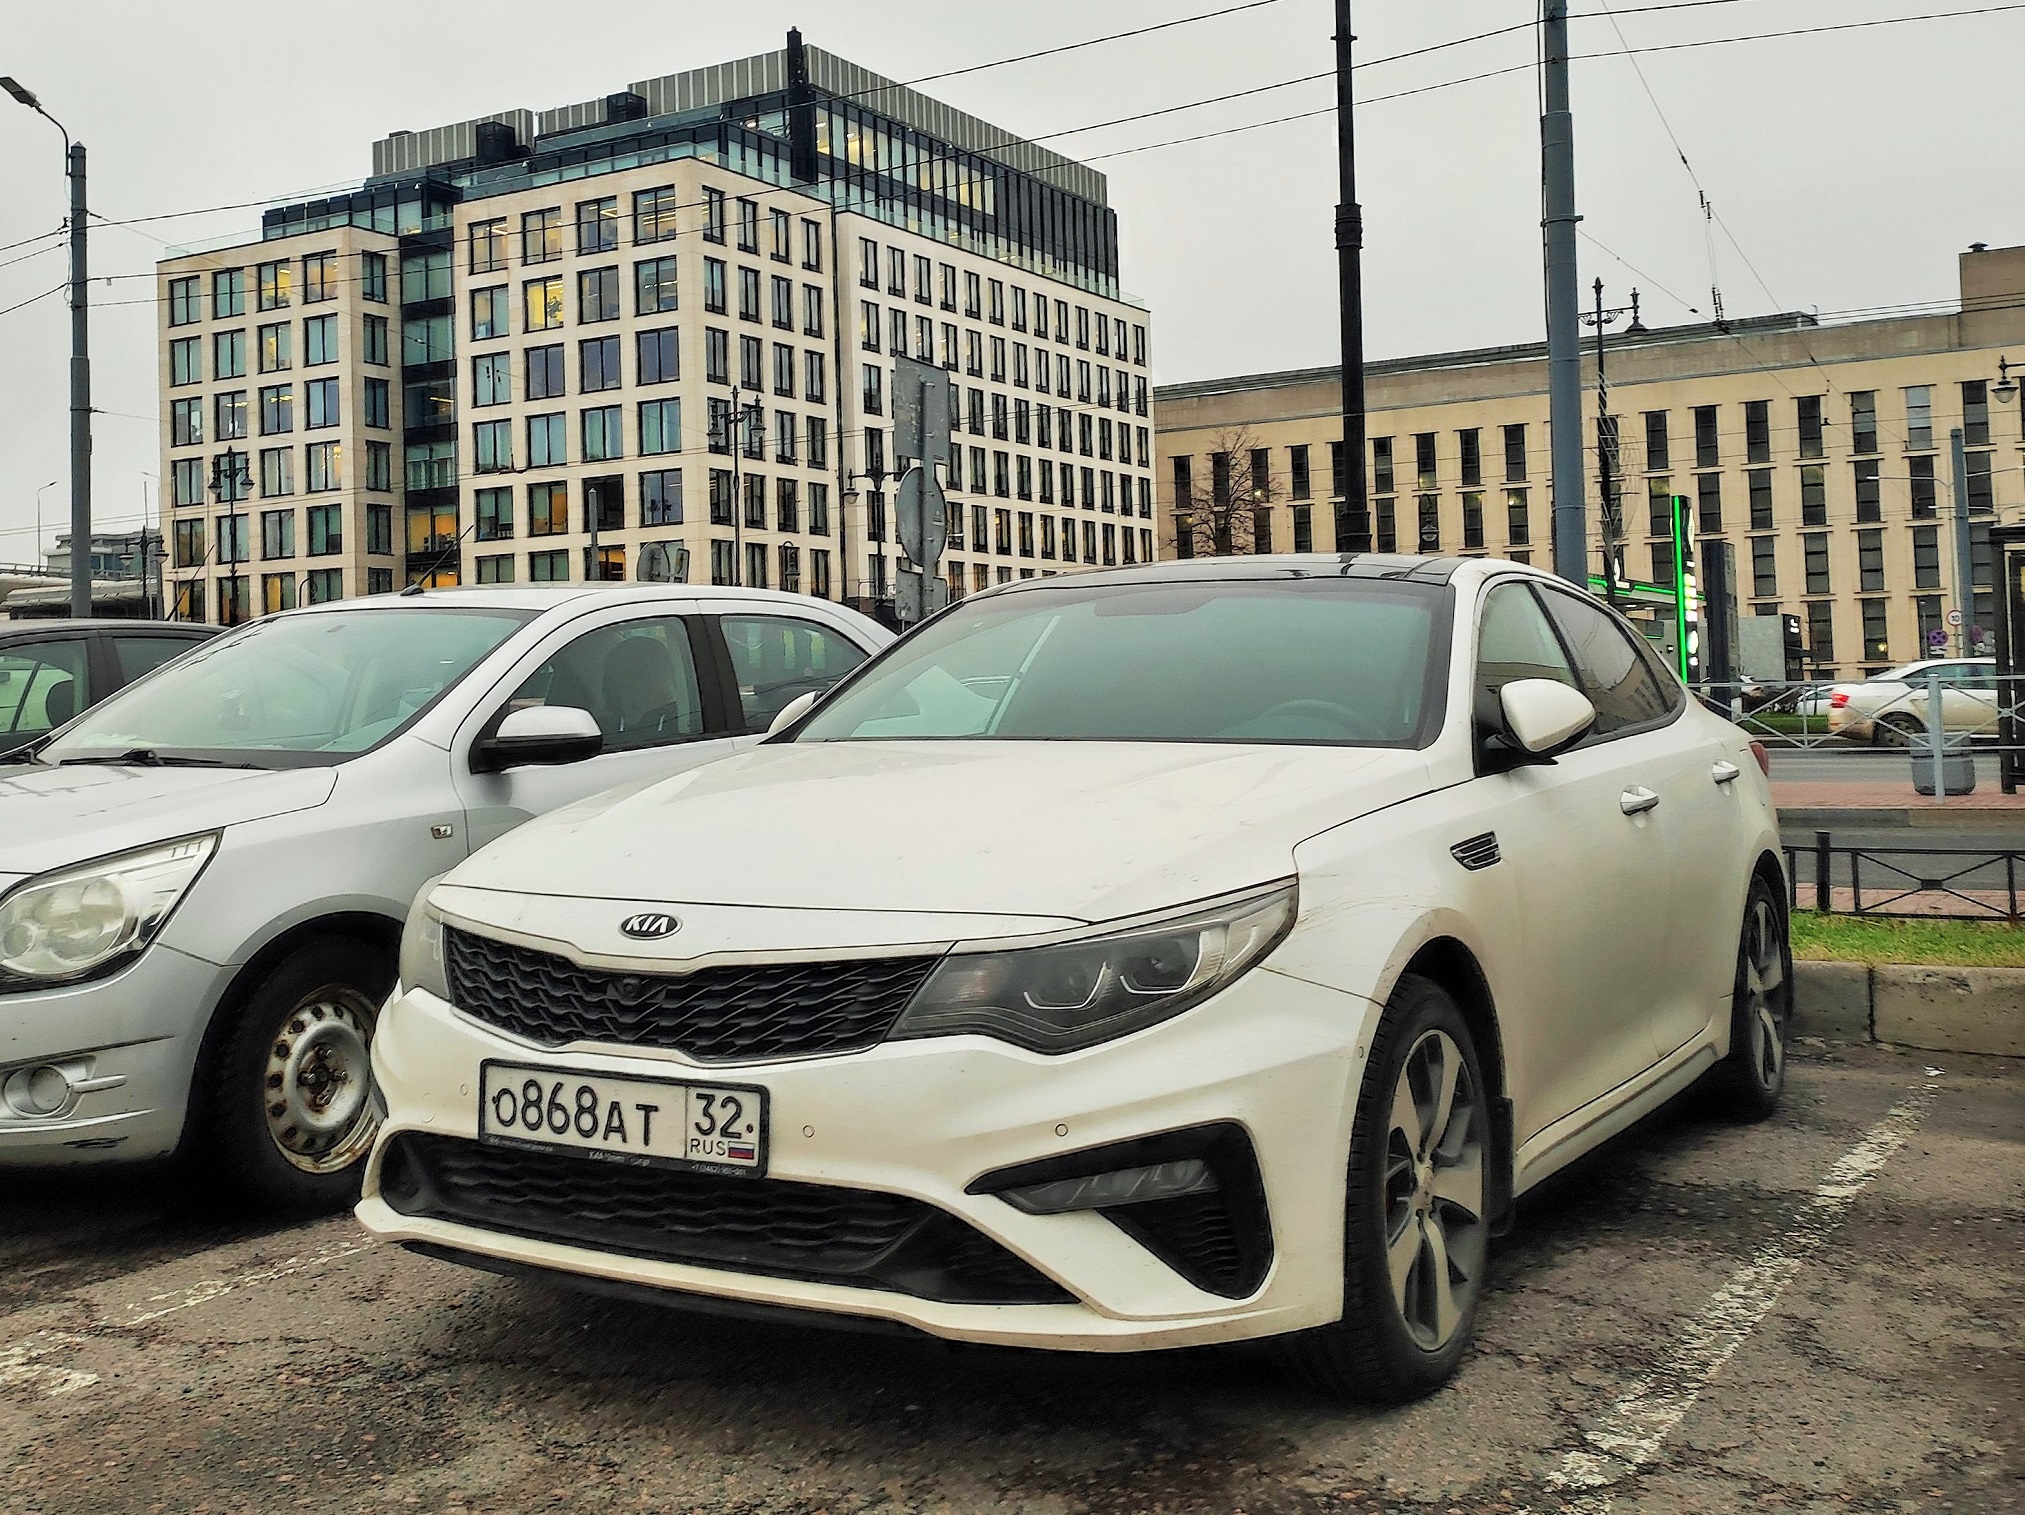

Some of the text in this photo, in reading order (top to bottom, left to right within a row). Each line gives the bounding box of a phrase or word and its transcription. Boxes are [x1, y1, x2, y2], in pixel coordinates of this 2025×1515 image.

[625, 915, 669, 933] KIA
[694, 1093, 743, 1139] 32
[690, 1138, 726, 1156] RUS
